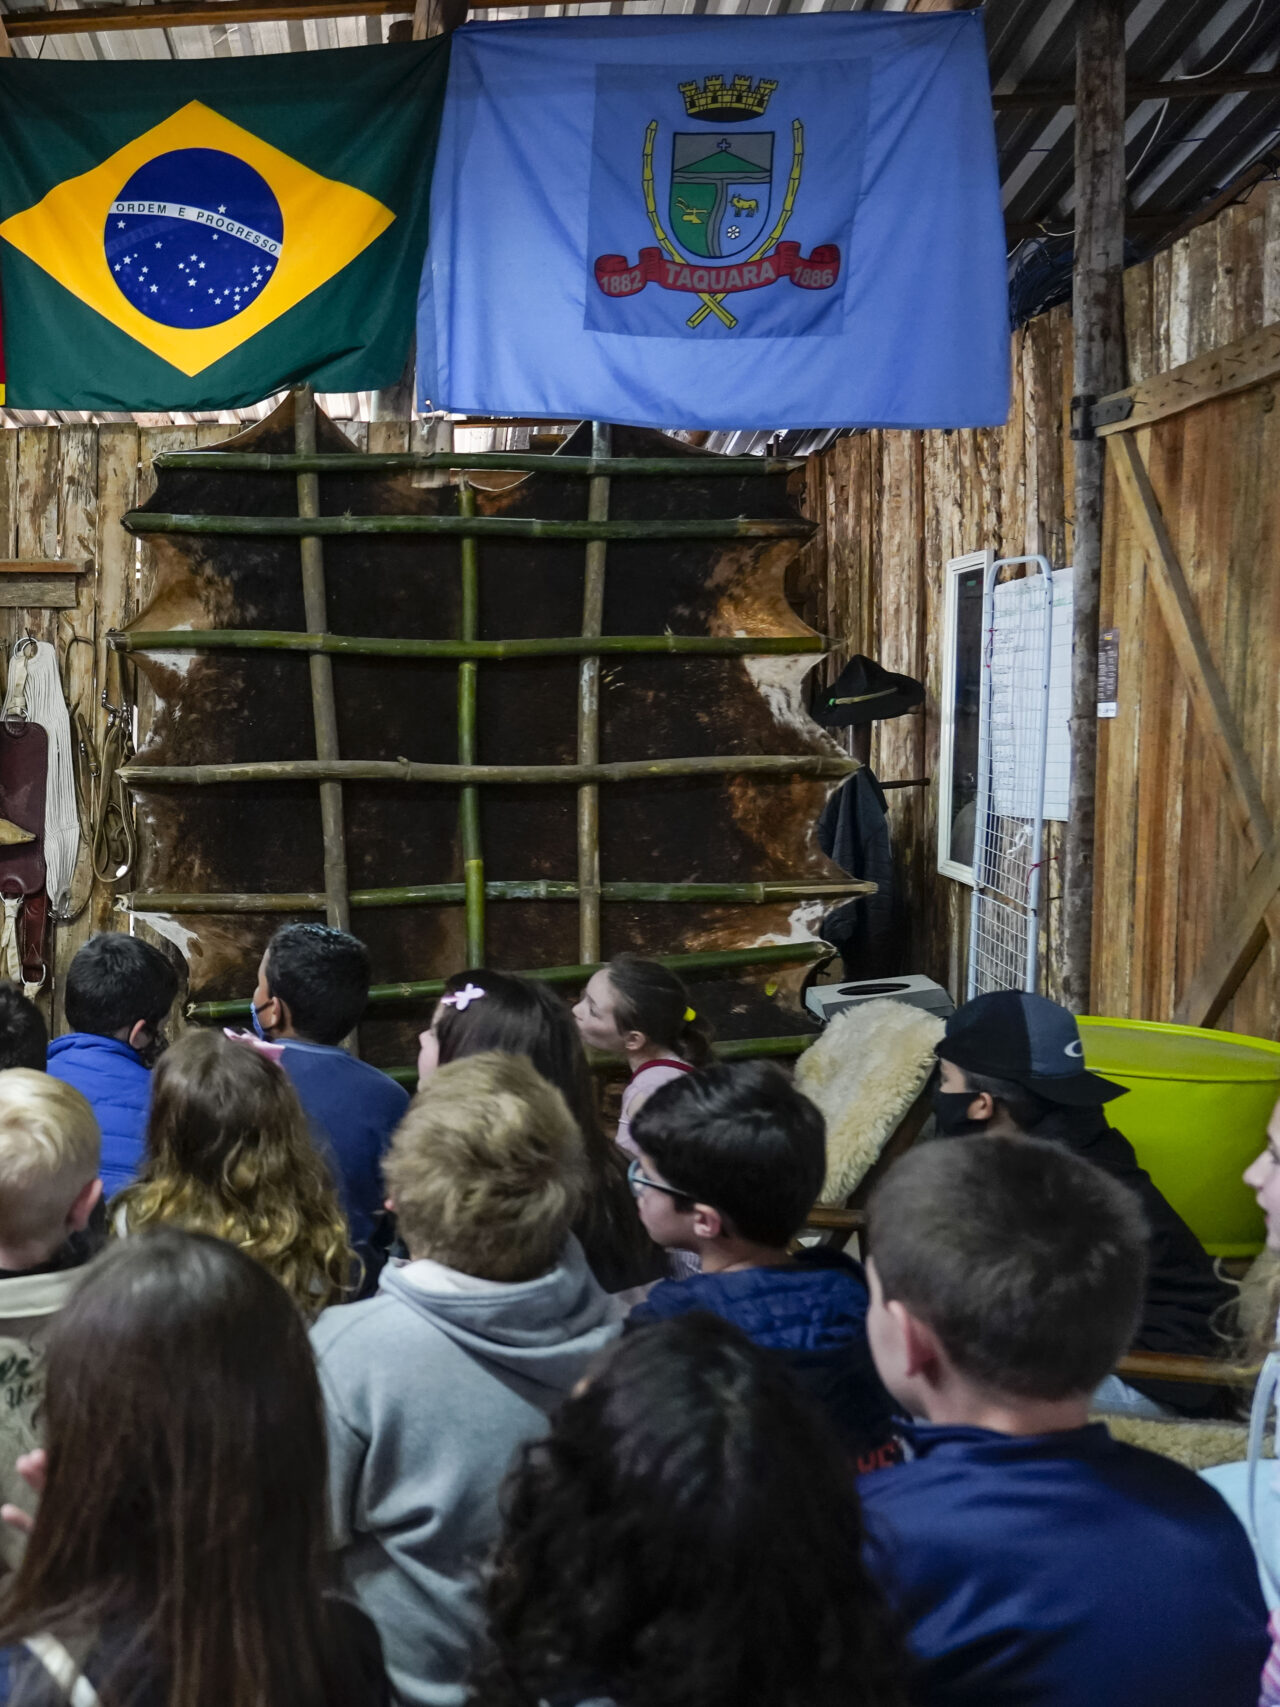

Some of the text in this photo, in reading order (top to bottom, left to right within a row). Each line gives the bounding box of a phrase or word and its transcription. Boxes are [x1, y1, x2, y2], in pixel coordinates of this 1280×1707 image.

[116, 203, 278, 253] ORDEM E PROGRESSO
[600, 261, 833, 293] 1882 TAQUARA 1886
